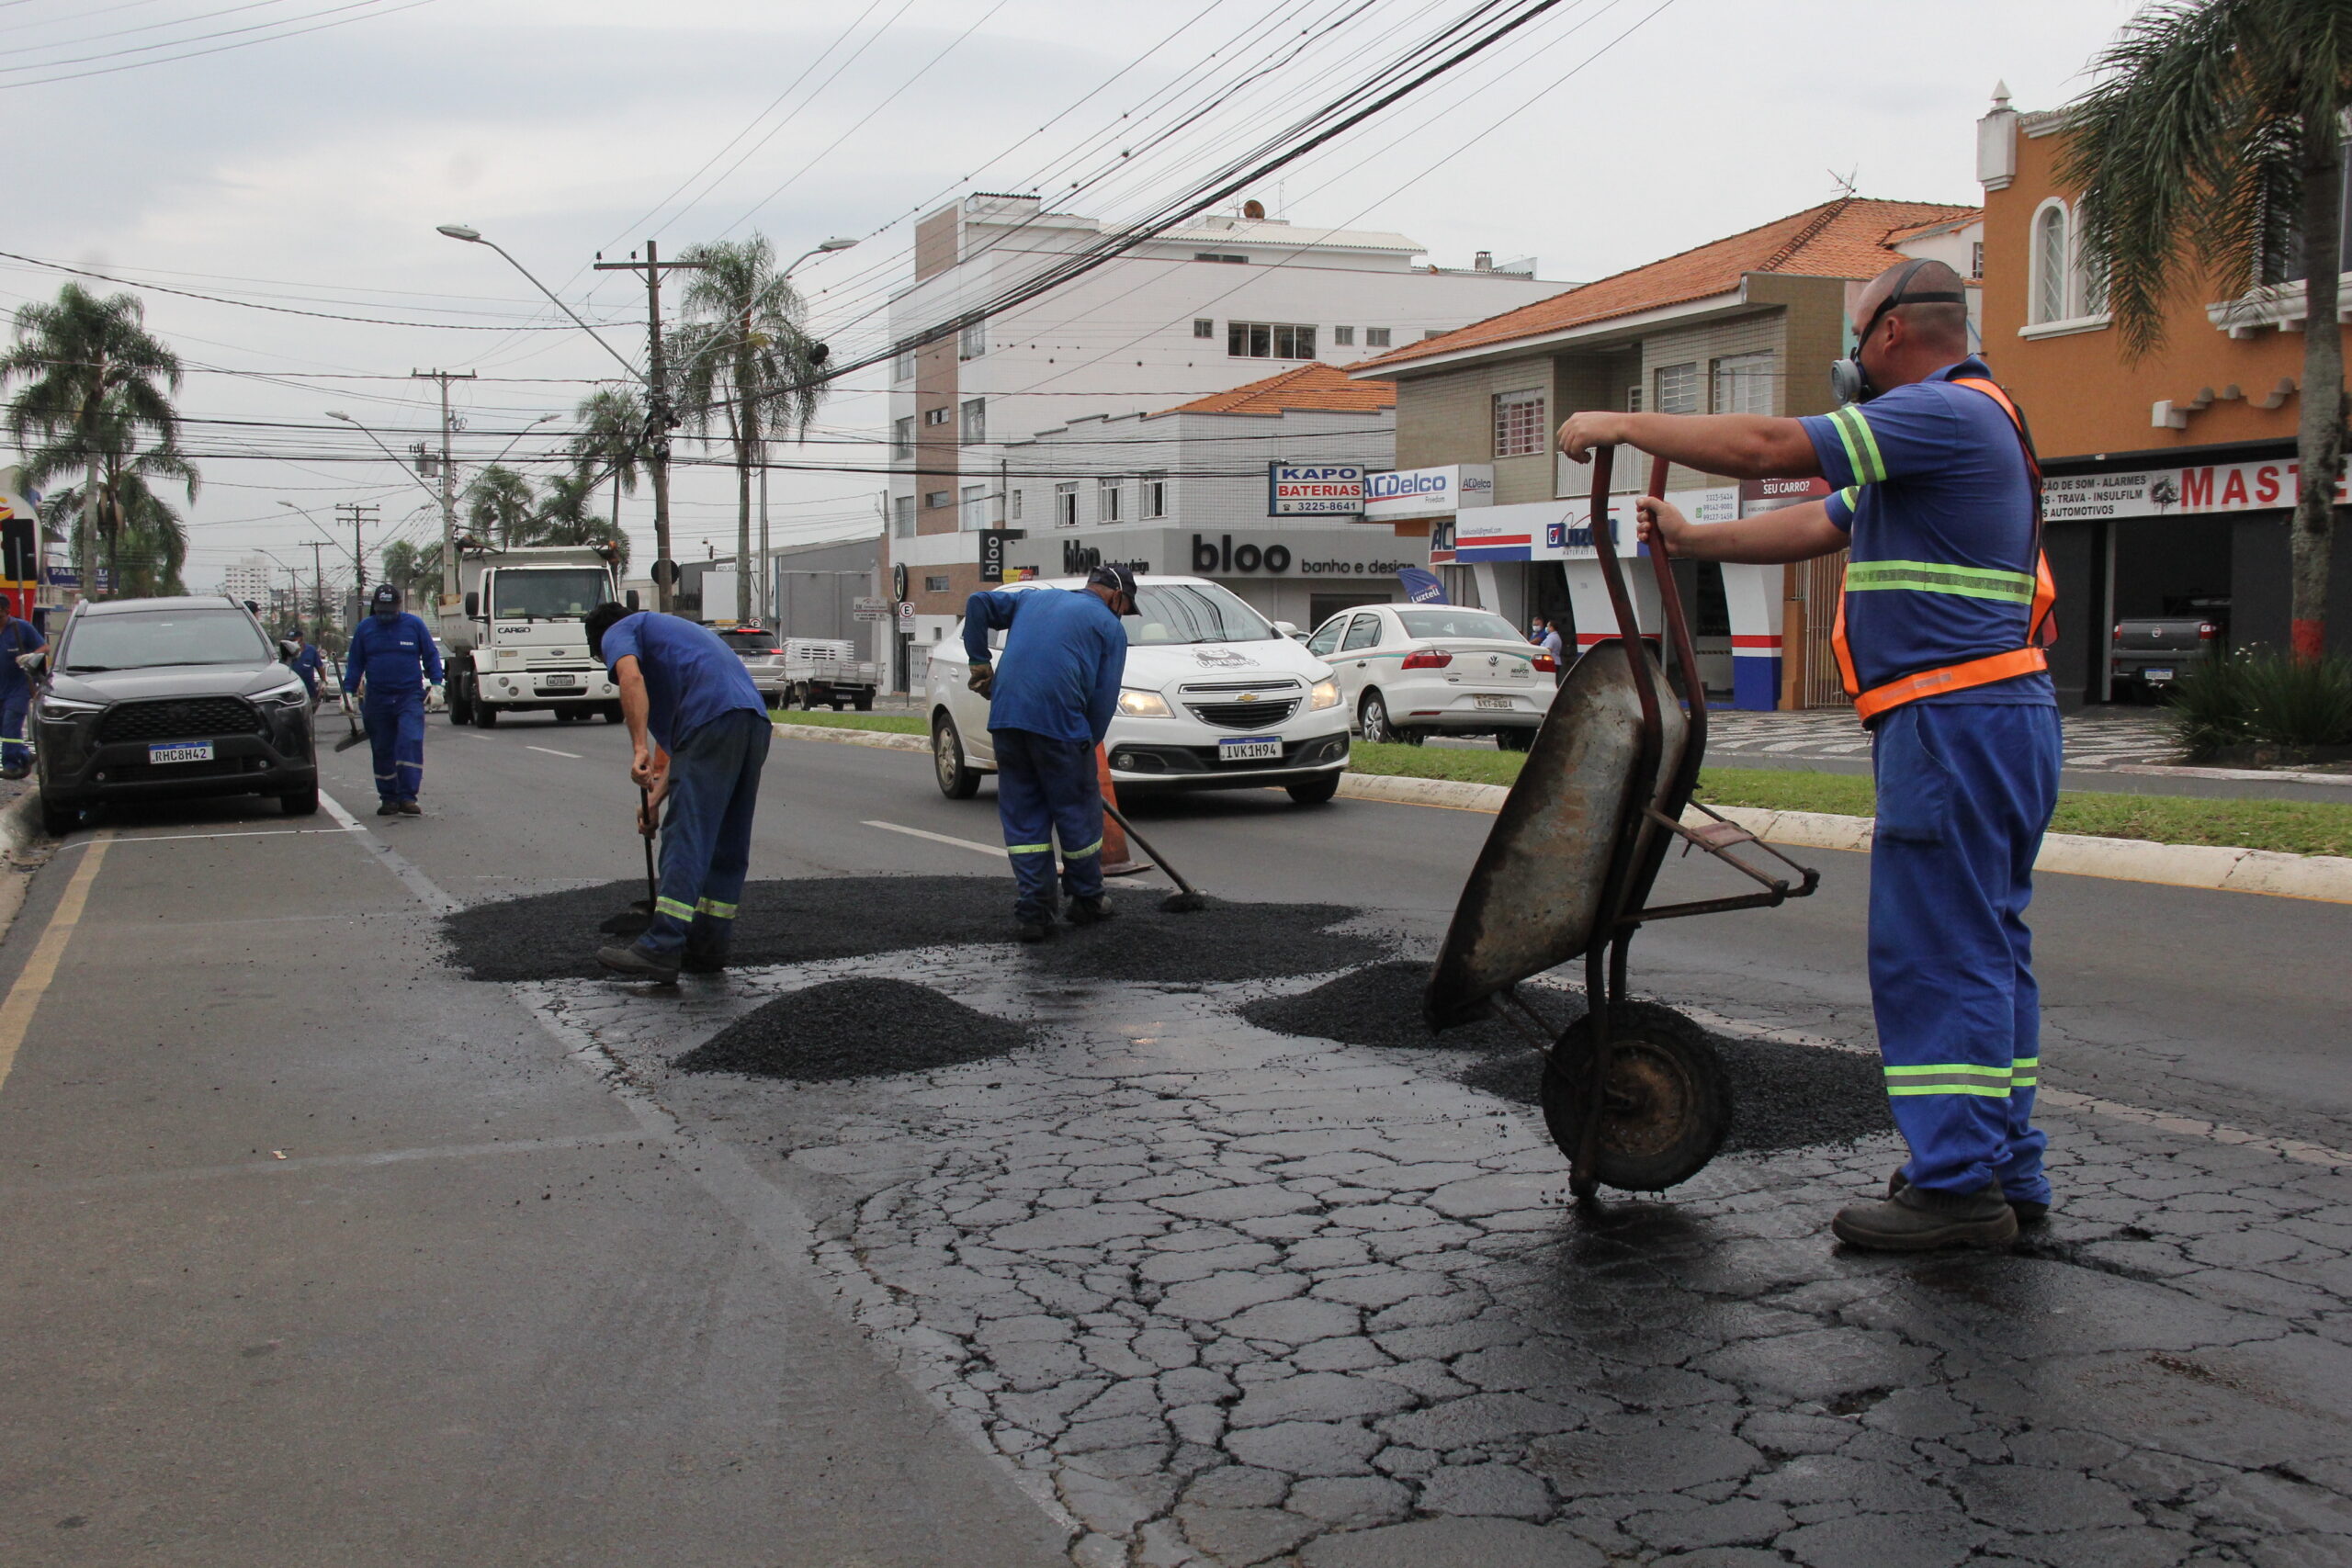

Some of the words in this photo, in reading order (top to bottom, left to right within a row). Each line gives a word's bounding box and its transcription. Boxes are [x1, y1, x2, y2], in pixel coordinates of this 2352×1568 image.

[1282, 468, 1357, 479] KAPO
[1363, 473, 1447, 497] ACDelco
[1463, 479, 1491, 489] ACDelco
[1763, 484, 1778, 494] SEU
[1780, 481, 1810, 493] CARRO?
[2062, 480, 2073, 490] DE
[2075, 479, 2095, 489] SOM
[2102, 475, 2146, 487] ALARMES
[1278, 485, 1361, 497] BATERIAS
[2057, 493, 2086, 503] TRAVA
[2093, 490, 2143, 502] INSULFILM
[1297, 502, 1356, 511] 3225-8641
[2050, 505, 2114, 517] AUTOMOTIVOS
[985, 536, 1000, 576] bloo
[1063, 539, 1101, 574] bloo
[1193, 534, 1292, 572] bloo
[1302, 558, 1351, 573] banho
[1354, 563, 1363, 573] e
[1411, 588, 1441, 604] Luztell
[904, 606, 910, 615] E
[155, 748, 207, 762] RHC8H42
[1227, 744, 1276, 759] IVK1H94
